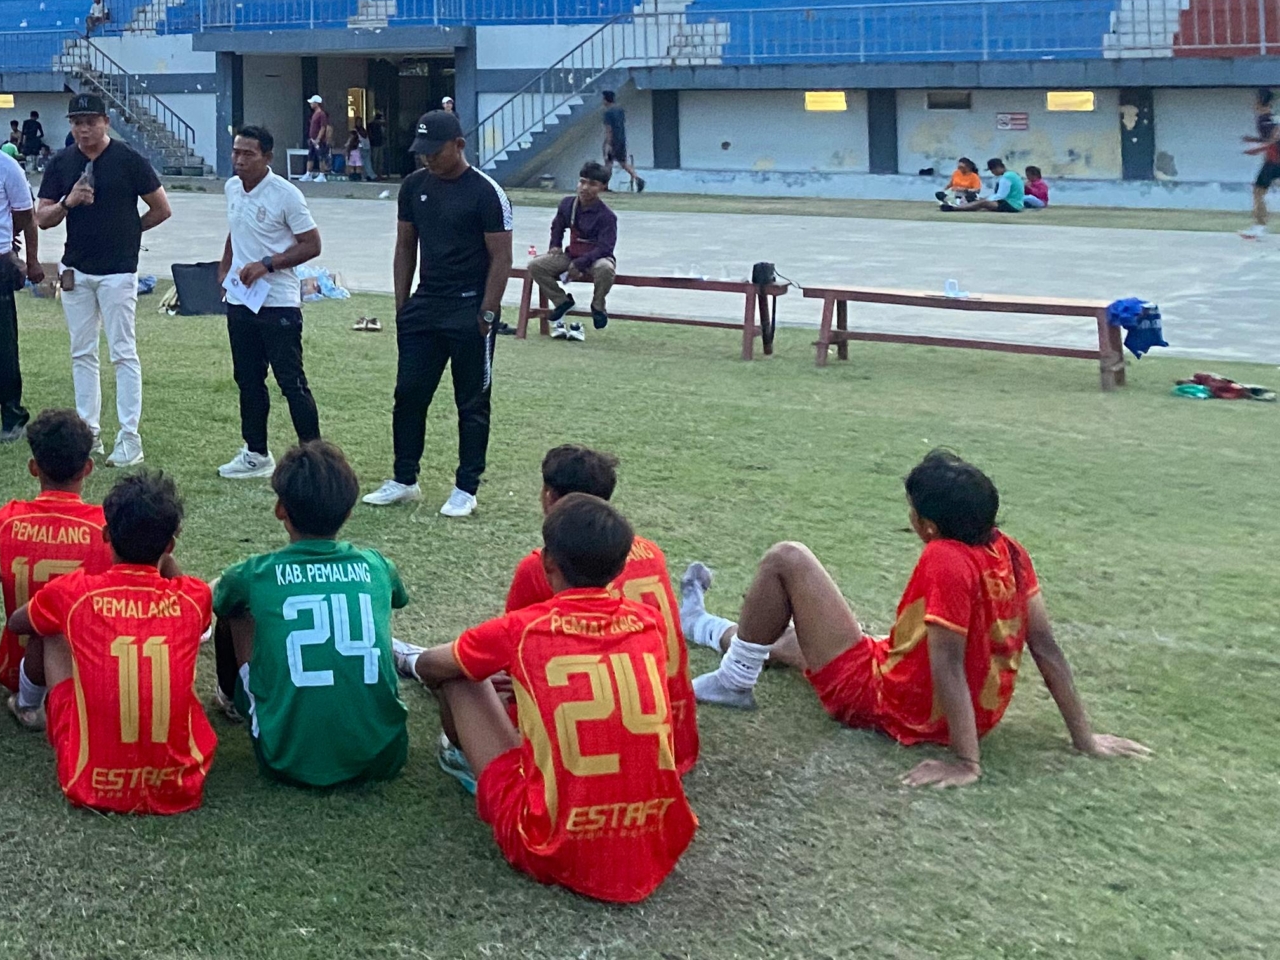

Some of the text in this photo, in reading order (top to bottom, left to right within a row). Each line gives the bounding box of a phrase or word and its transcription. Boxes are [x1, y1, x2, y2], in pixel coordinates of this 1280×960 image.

[11, 520, 91, 545] PEMALANG
[275, 562, 371, 585] KAB. PEMALANG
[92, 596, 182, 619] PEMALANG
[282, 593, 381, 688] 24
[110, 635, 171, 744] 11
[544, 652, 676, 777] 24
